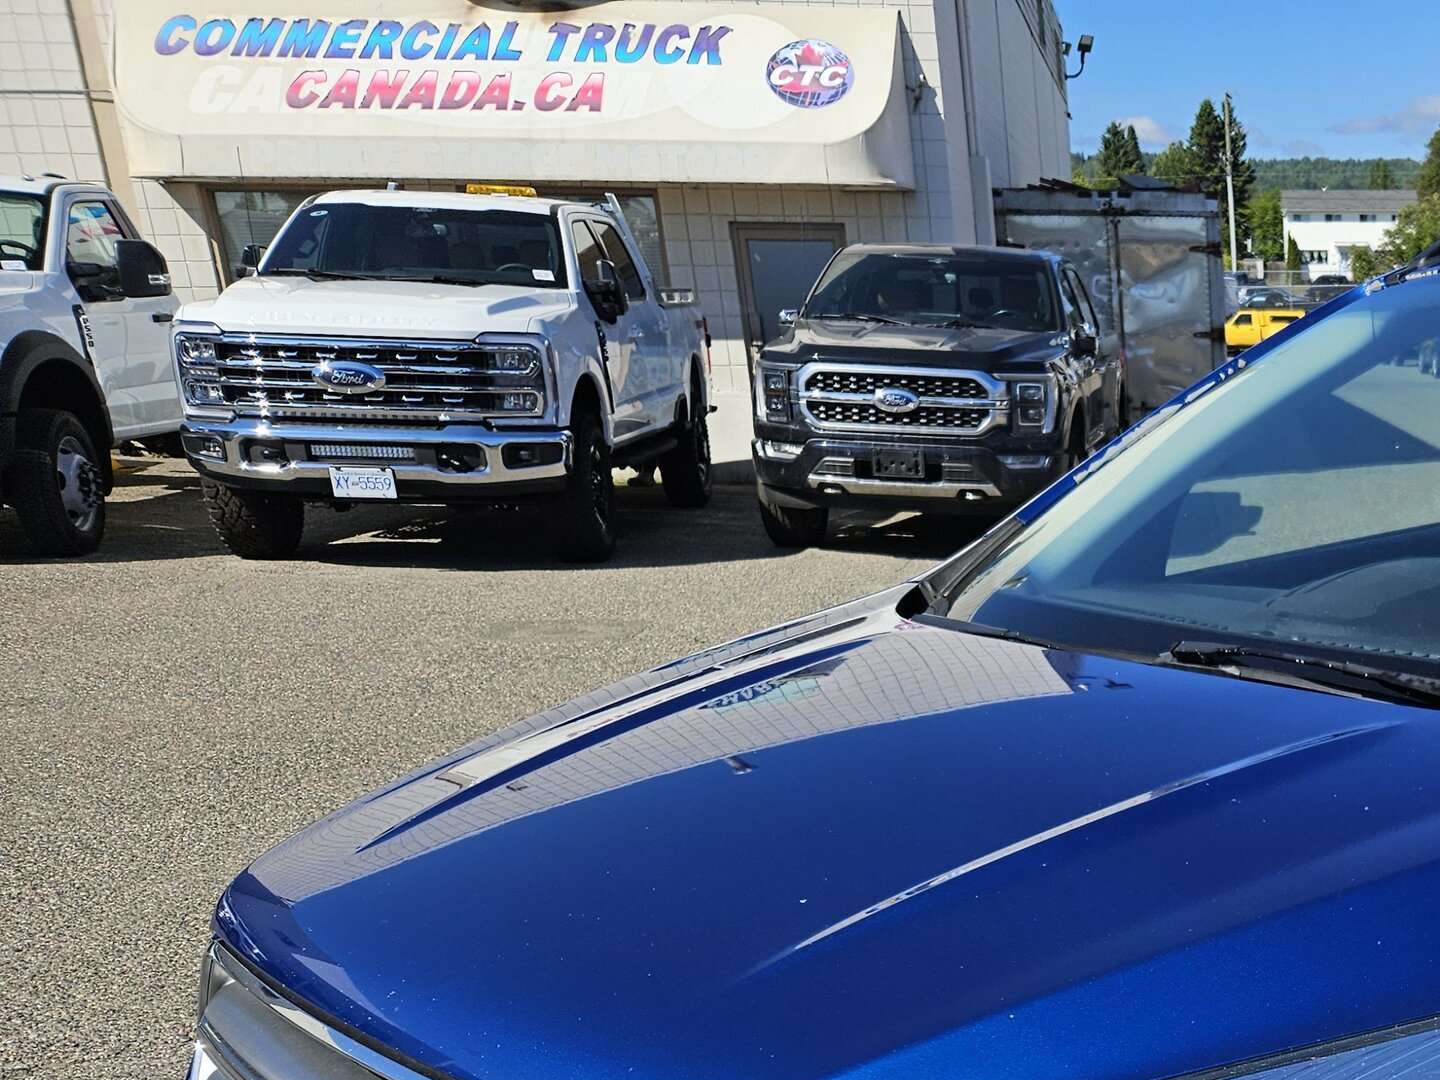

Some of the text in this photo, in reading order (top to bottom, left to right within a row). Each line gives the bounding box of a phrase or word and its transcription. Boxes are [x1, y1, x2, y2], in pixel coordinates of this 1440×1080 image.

[154, 14, 734, 65] COMMERCIAL TRUCK
[769, 64, 848, 88] CTC
[285, 69, 605, 112] CANADA.CA
[330, 369, 365, 384] Ford
[334, 476, 392, 491] XY 5559
